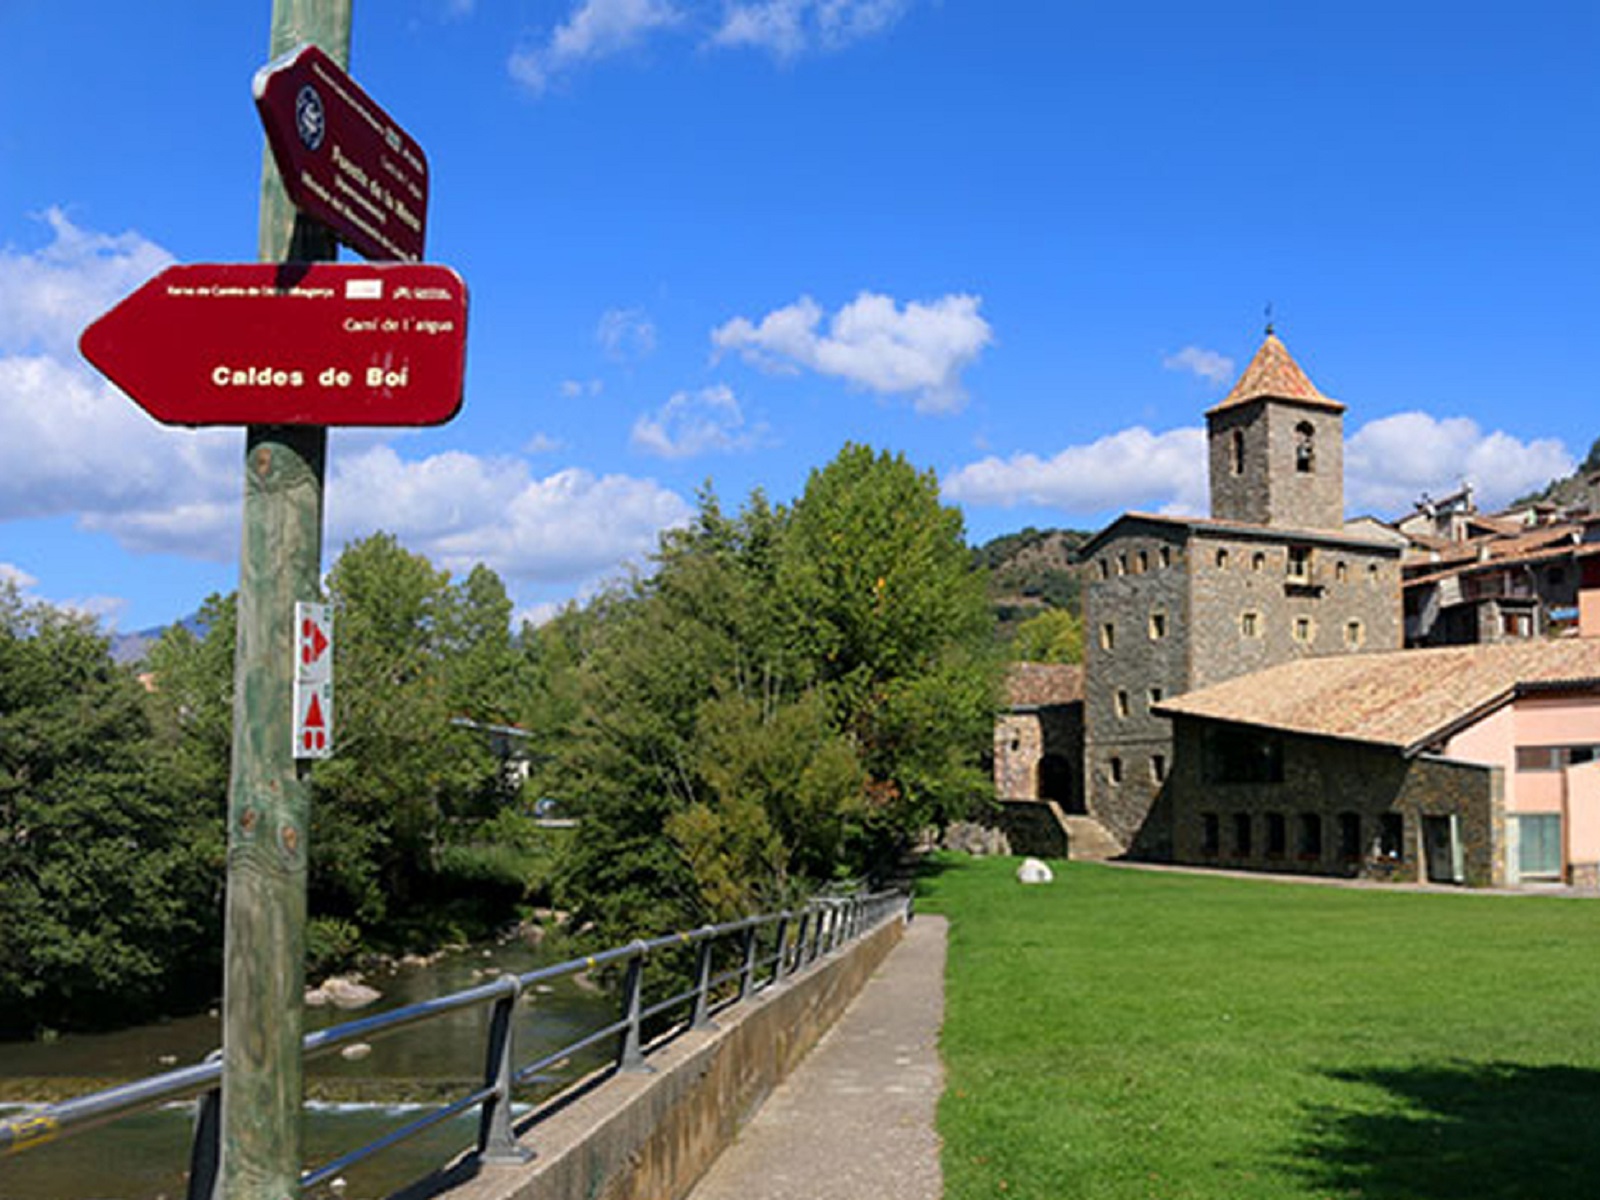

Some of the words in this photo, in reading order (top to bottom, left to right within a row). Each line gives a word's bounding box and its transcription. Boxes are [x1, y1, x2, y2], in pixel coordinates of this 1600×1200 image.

[380, 317, 400, 332] de
[211, 366, 304, 387] Caldes
[318, 367, 352, 387] de
